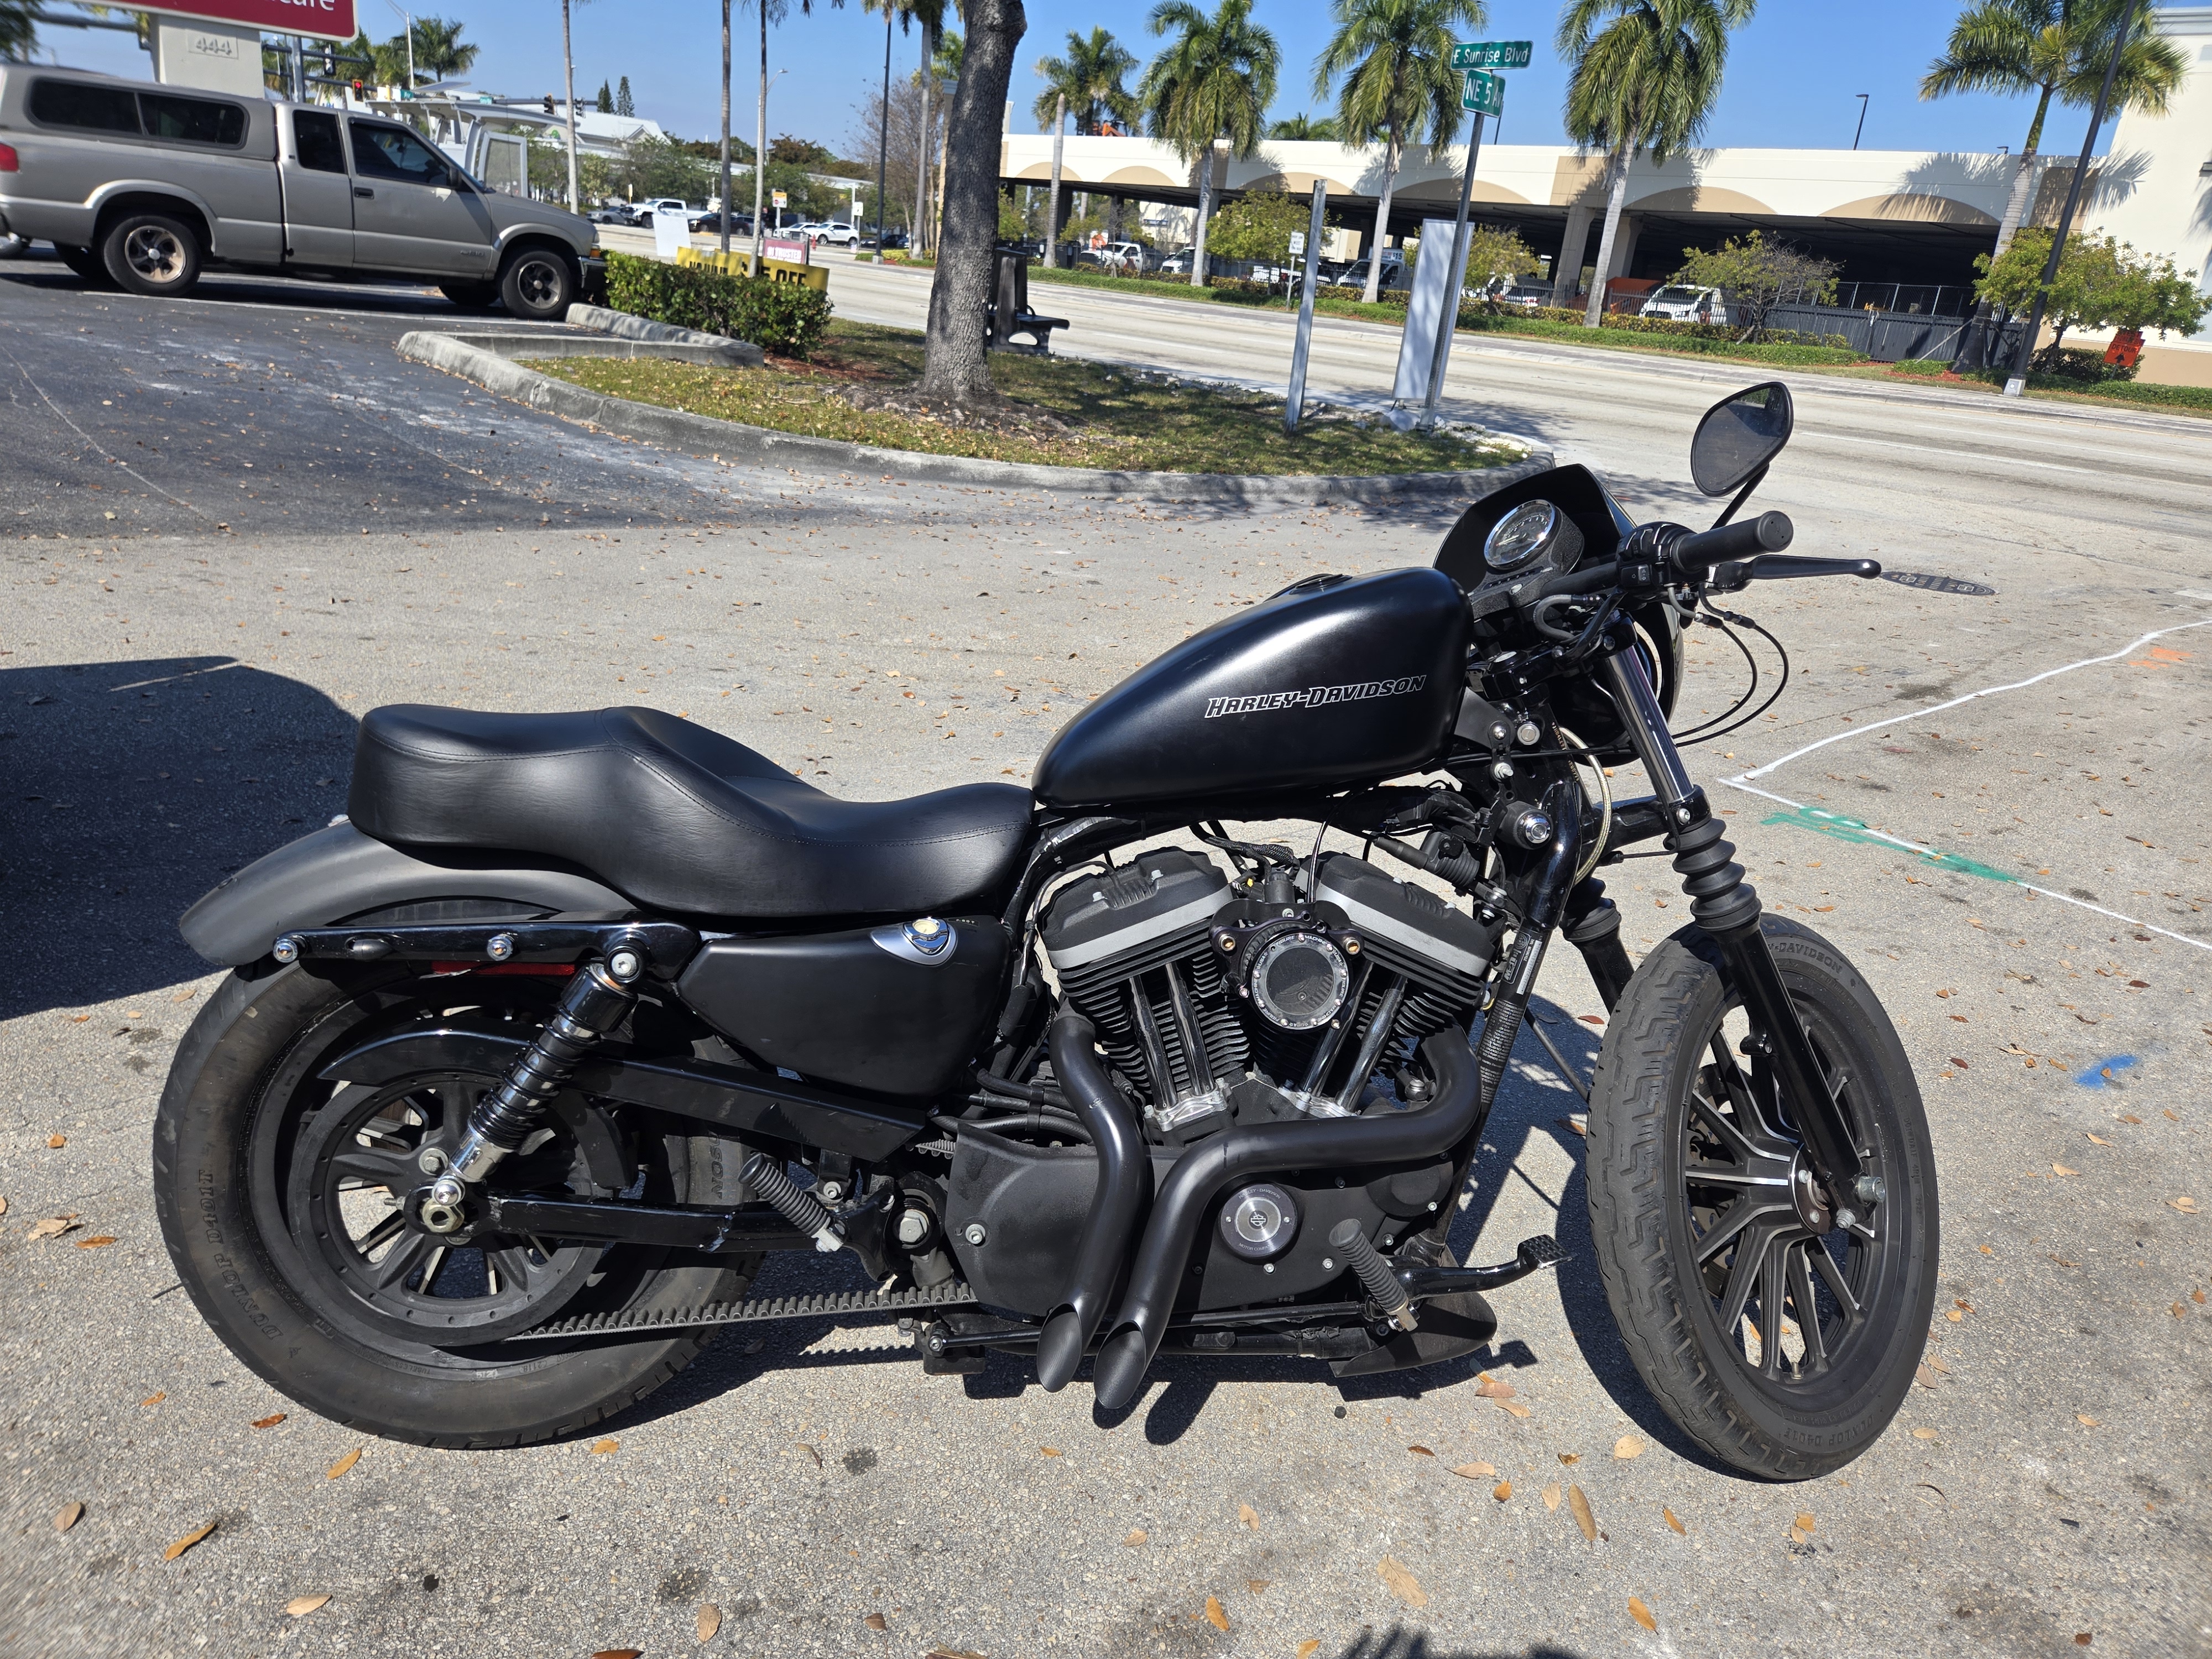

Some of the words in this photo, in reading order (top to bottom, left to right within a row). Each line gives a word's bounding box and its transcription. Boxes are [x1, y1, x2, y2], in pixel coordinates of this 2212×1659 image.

[196, 36, 232, 55] 444
[1454, 49, 1461, 64] E
[1464, 48, 1500, 63] Sunrise
[1504, 47, 1529, 62] Blvd
[1466, 77, 1483, 102] NE
[1484, 82, 1493, 105] 5
[775, 247, 802, 260] TRUSTED
[2112, 343, 2137, 353] DETOUR
[1204, 675, 1427, 718] HARLEY-DAVIDSON
[1305, 935, 1328, 946] MACHINE
[199, 1169, 224, 1244] D401T
[214, 1253, 284, 1340] DUNLOP
[394, 1361, 430, 1375] TUBELESS
[1828, 1414, 1874, 1446] DUNLOP
